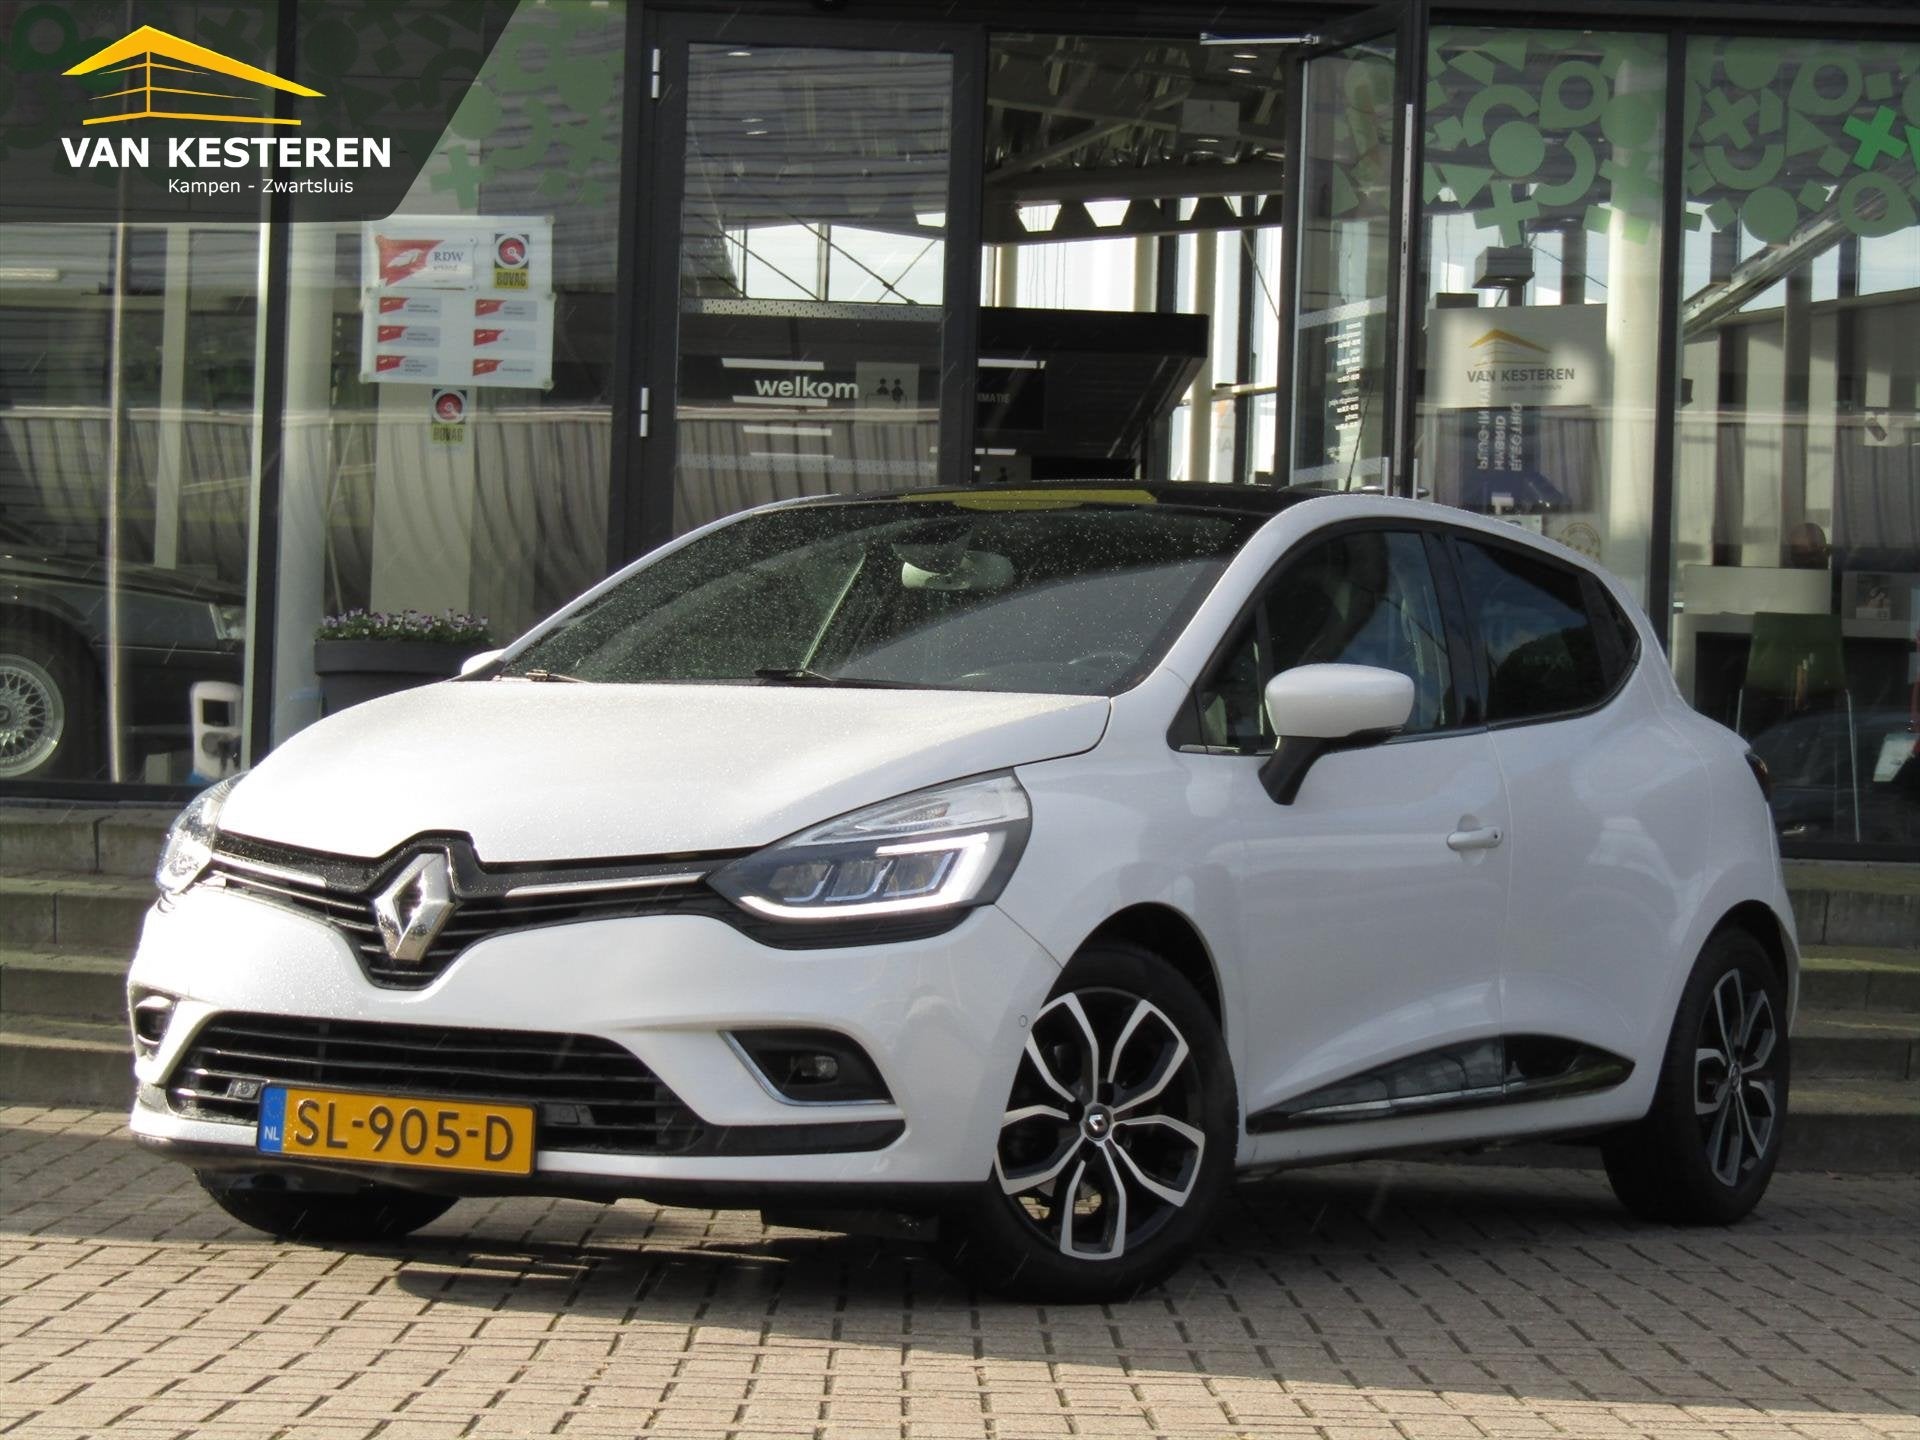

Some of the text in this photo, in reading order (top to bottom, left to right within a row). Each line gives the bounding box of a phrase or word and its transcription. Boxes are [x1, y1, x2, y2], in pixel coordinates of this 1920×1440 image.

[433, 251, 464, 261] RDW
[496, 271, 527, 286] BOVAG
[1467, 368, 1575, 382] VAN KESTEREN
[754, 375, 860, 398] welkom
[264, 1126, 280, 1141] NL
[295, 1099, 513, 1162] SL-905-D
